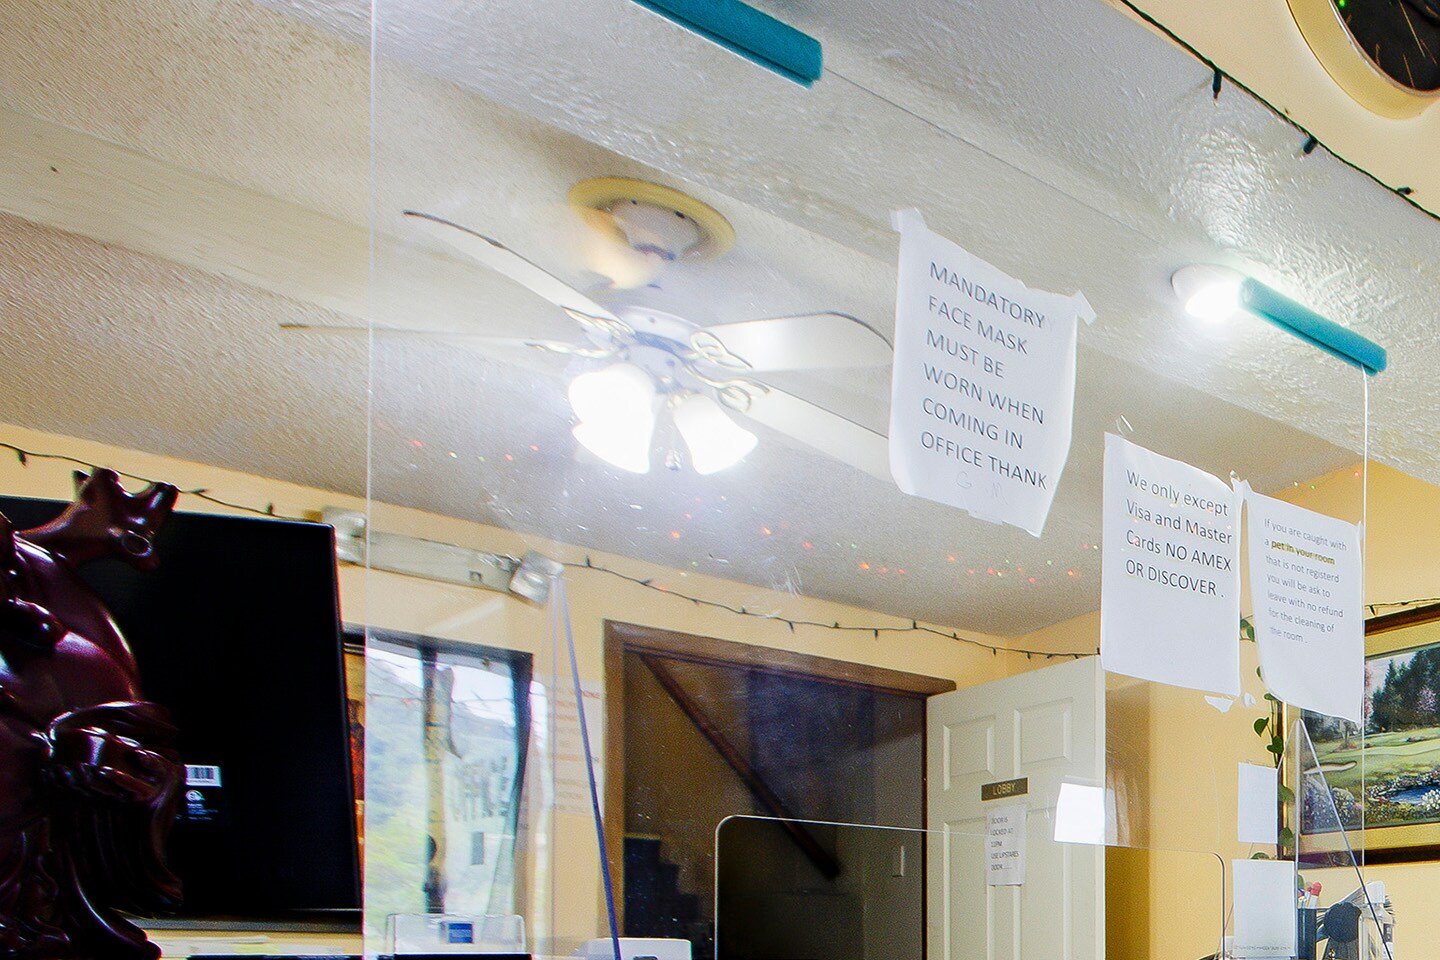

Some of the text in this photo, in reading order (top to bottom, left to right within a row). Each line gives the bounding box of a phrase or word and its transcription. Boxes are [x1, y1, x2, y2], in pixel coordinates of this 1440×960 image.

[929, 261, 1045, 328] MANDATORY
[928, 295, 1028, 355] FACE MASK
[926, 329, 1005, 379] MUST BE
[924, 362, 1044, 424] WORN WHEN
[922, 397, 1023, 449] COMING IN
[921, 431, 1047, 490] OFFICE THANK
[1126, 469, 1228, 517] We only except
[1126, 499, 1232, 544] Visa and Master
[1264, 518, 1347, 551] If you are caught with
[1126, 530, 1232, 571] Cards NO AMEX
[1265, 555, 1340, 583] that is not registerd
[1271, 541, 1285, 551] pet
[1286, 543, 1295, 552] in
[1296, 547, 1315, 558] your
[1315, 553, 1336, 565] room
[1126, 559, 1144, 578] OR
[1148, 566, 1216, 596] DISCOVER
[1267, 573, 1331, 598] you will be ask to
[1267, 590, 1344, 618] leave with no refund
[1268, 608, 1335, 632] for the cleaning of
[1283, 631, 1304, 643] room
[993, 782, 1016, 795] LOBBY
